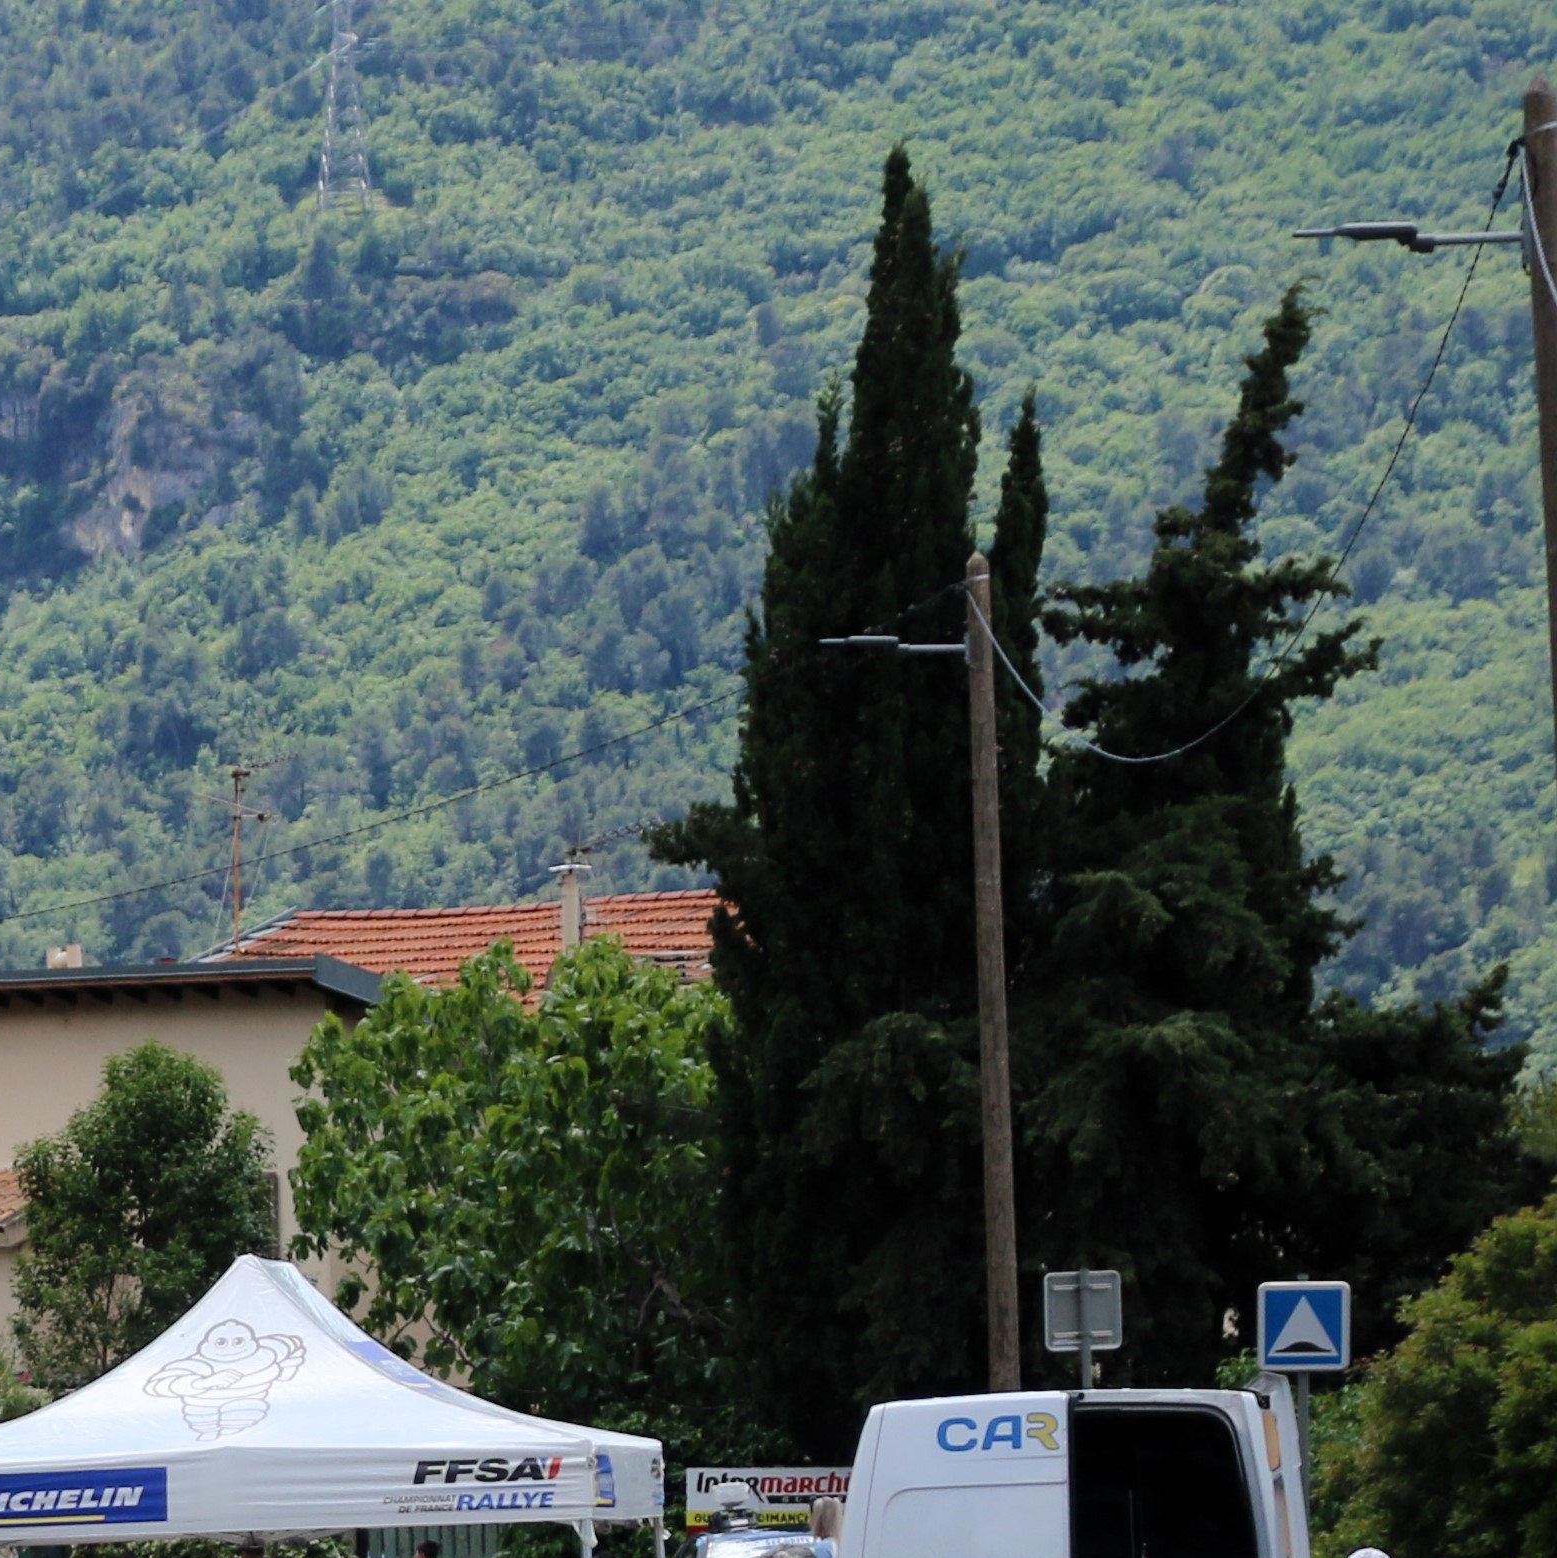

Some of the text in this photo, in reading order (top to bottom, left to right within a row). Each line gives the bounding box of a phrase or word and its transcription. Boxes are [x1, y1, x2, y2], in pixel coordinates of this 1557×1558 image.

[937, 1411, 1060, 1452] CAR
[413, 1457, 547, 1485] FFSA
[383, 1490, 555, 1512] CHAMPIONNAT RALLYE
[398, 1504, 455, 1514] DE FRANCE
